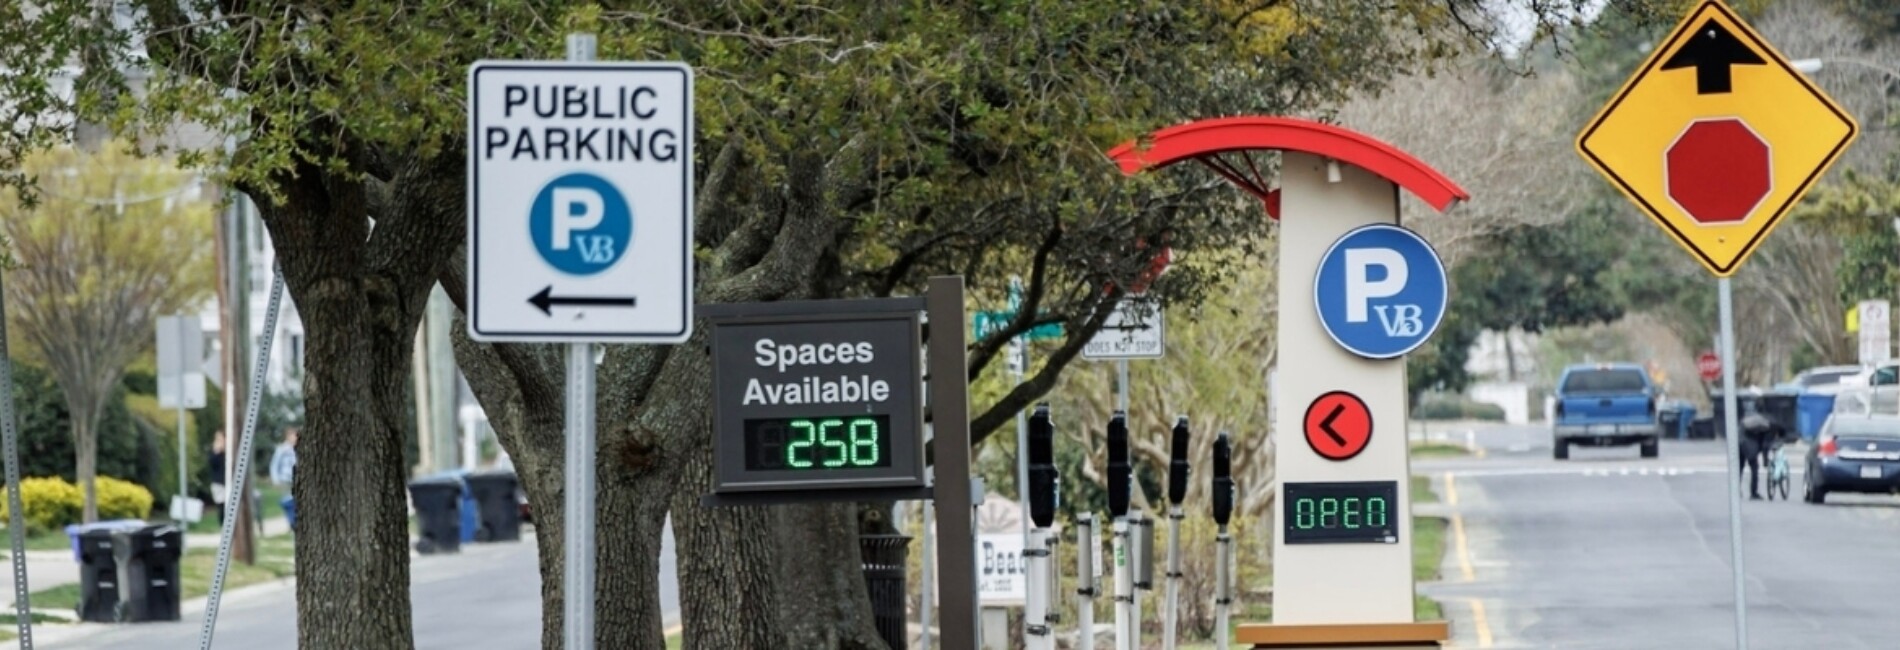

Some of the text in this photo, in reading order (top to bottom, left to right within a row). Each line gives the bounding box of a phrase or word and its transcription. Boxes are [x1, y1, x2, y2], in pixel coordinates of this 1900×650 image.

[504, 84, 658, 120] PUBLIC
[485, 126, 678, 162] PARKING
[551, 186, 605, 251] P
[574, 234, 615, 264] VB
[1345, 247, 1409, 323] P
[1373, 303, 1424, 338] VB
[754, 338, 874, 372] Spaces
[1136, 340, 1158, 352] STOP
[742, 374, 890, 405] Available
[787, 418, 879, 467] 258
[1296, 496, 1386, 529] OPEN
